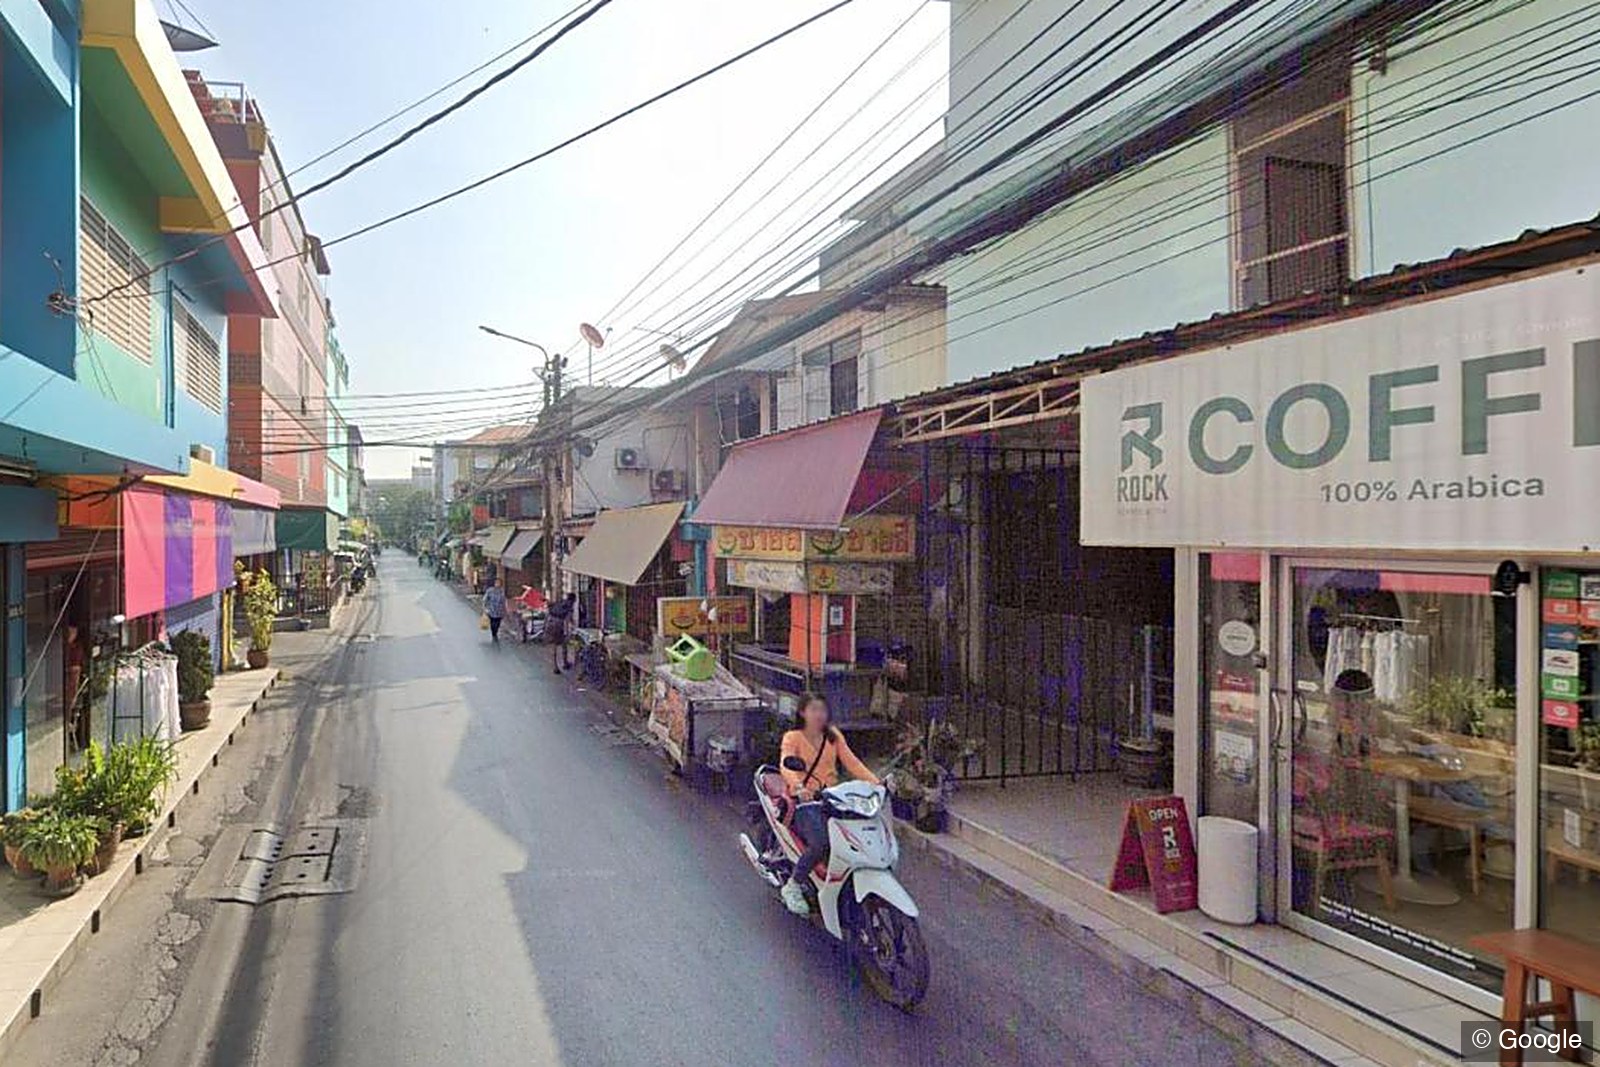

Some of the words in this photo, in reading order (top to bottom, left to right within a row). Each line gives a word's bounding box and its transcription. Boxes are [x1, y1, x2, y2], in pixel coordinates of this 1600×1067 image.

[1117, 473, 1169, 503] ROCK
[1321, 480, 1398, 503] 100%
[1407, 474, 1545, 500] Arabica
[1148, 807, 1178, 822] OPEN
